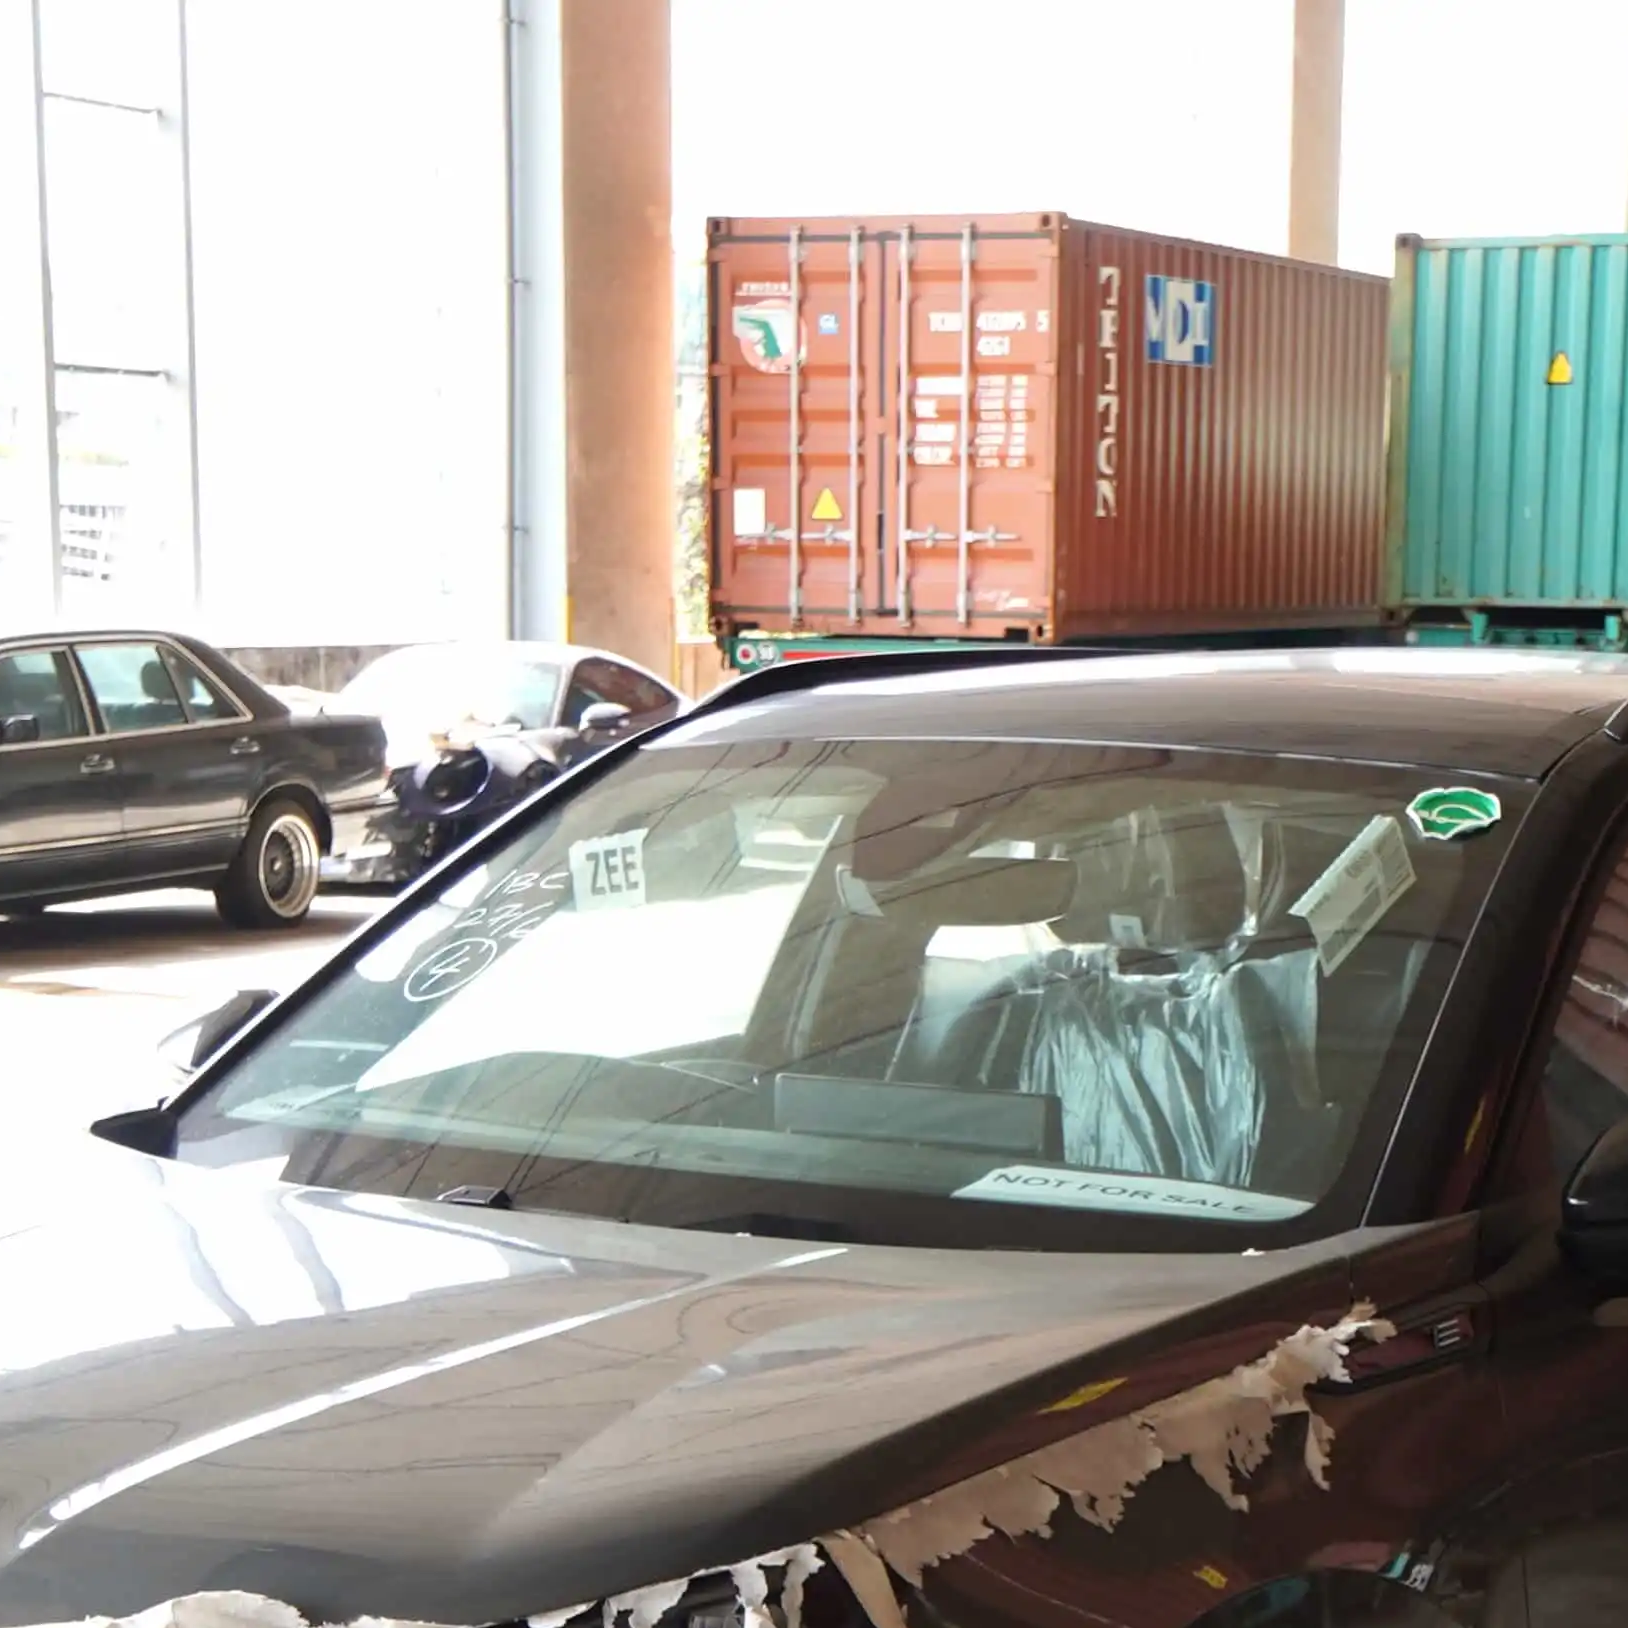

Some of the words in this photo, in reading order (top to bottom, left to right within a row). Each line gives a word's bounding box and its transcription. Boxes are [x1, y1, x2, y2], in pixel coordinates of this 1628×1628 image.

[585, 845, 641, 896] ZEE
[993, 1173, 1065, 1189] NOT
[1076, 1183, 1153, 1201] FOR
[1159, 1193, 1258, 1215] SALE
